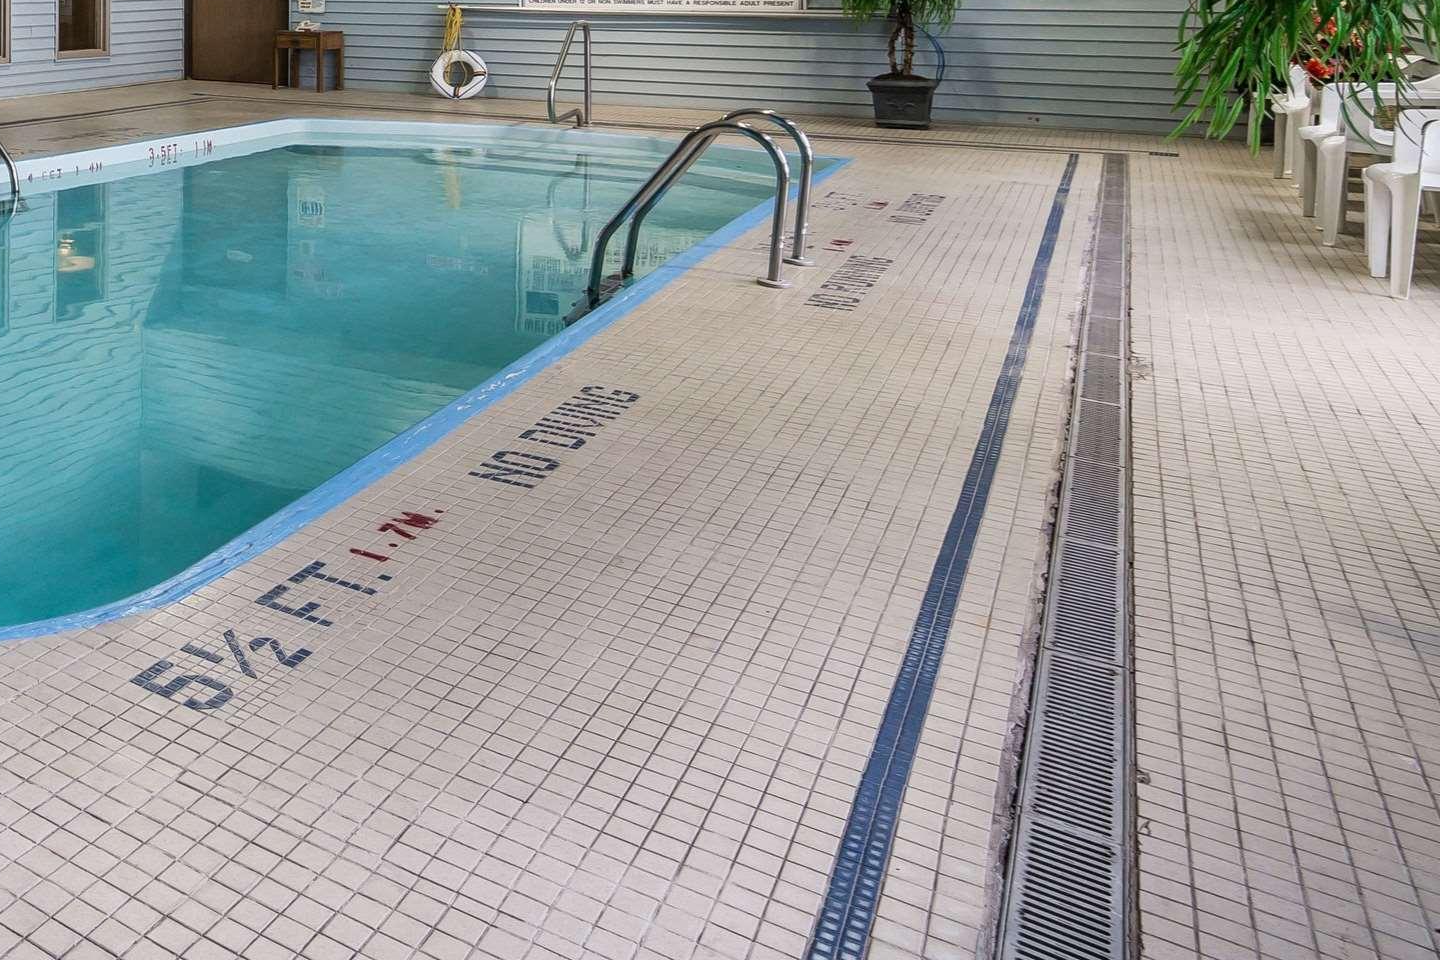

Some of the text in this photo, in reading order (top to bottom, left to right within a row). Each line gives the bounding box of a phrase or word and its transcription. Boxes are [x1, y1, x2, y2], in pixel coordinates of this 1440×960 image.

[803, 293, 860, 311] NO
[467, 384, 640, 489] NO DIVING
